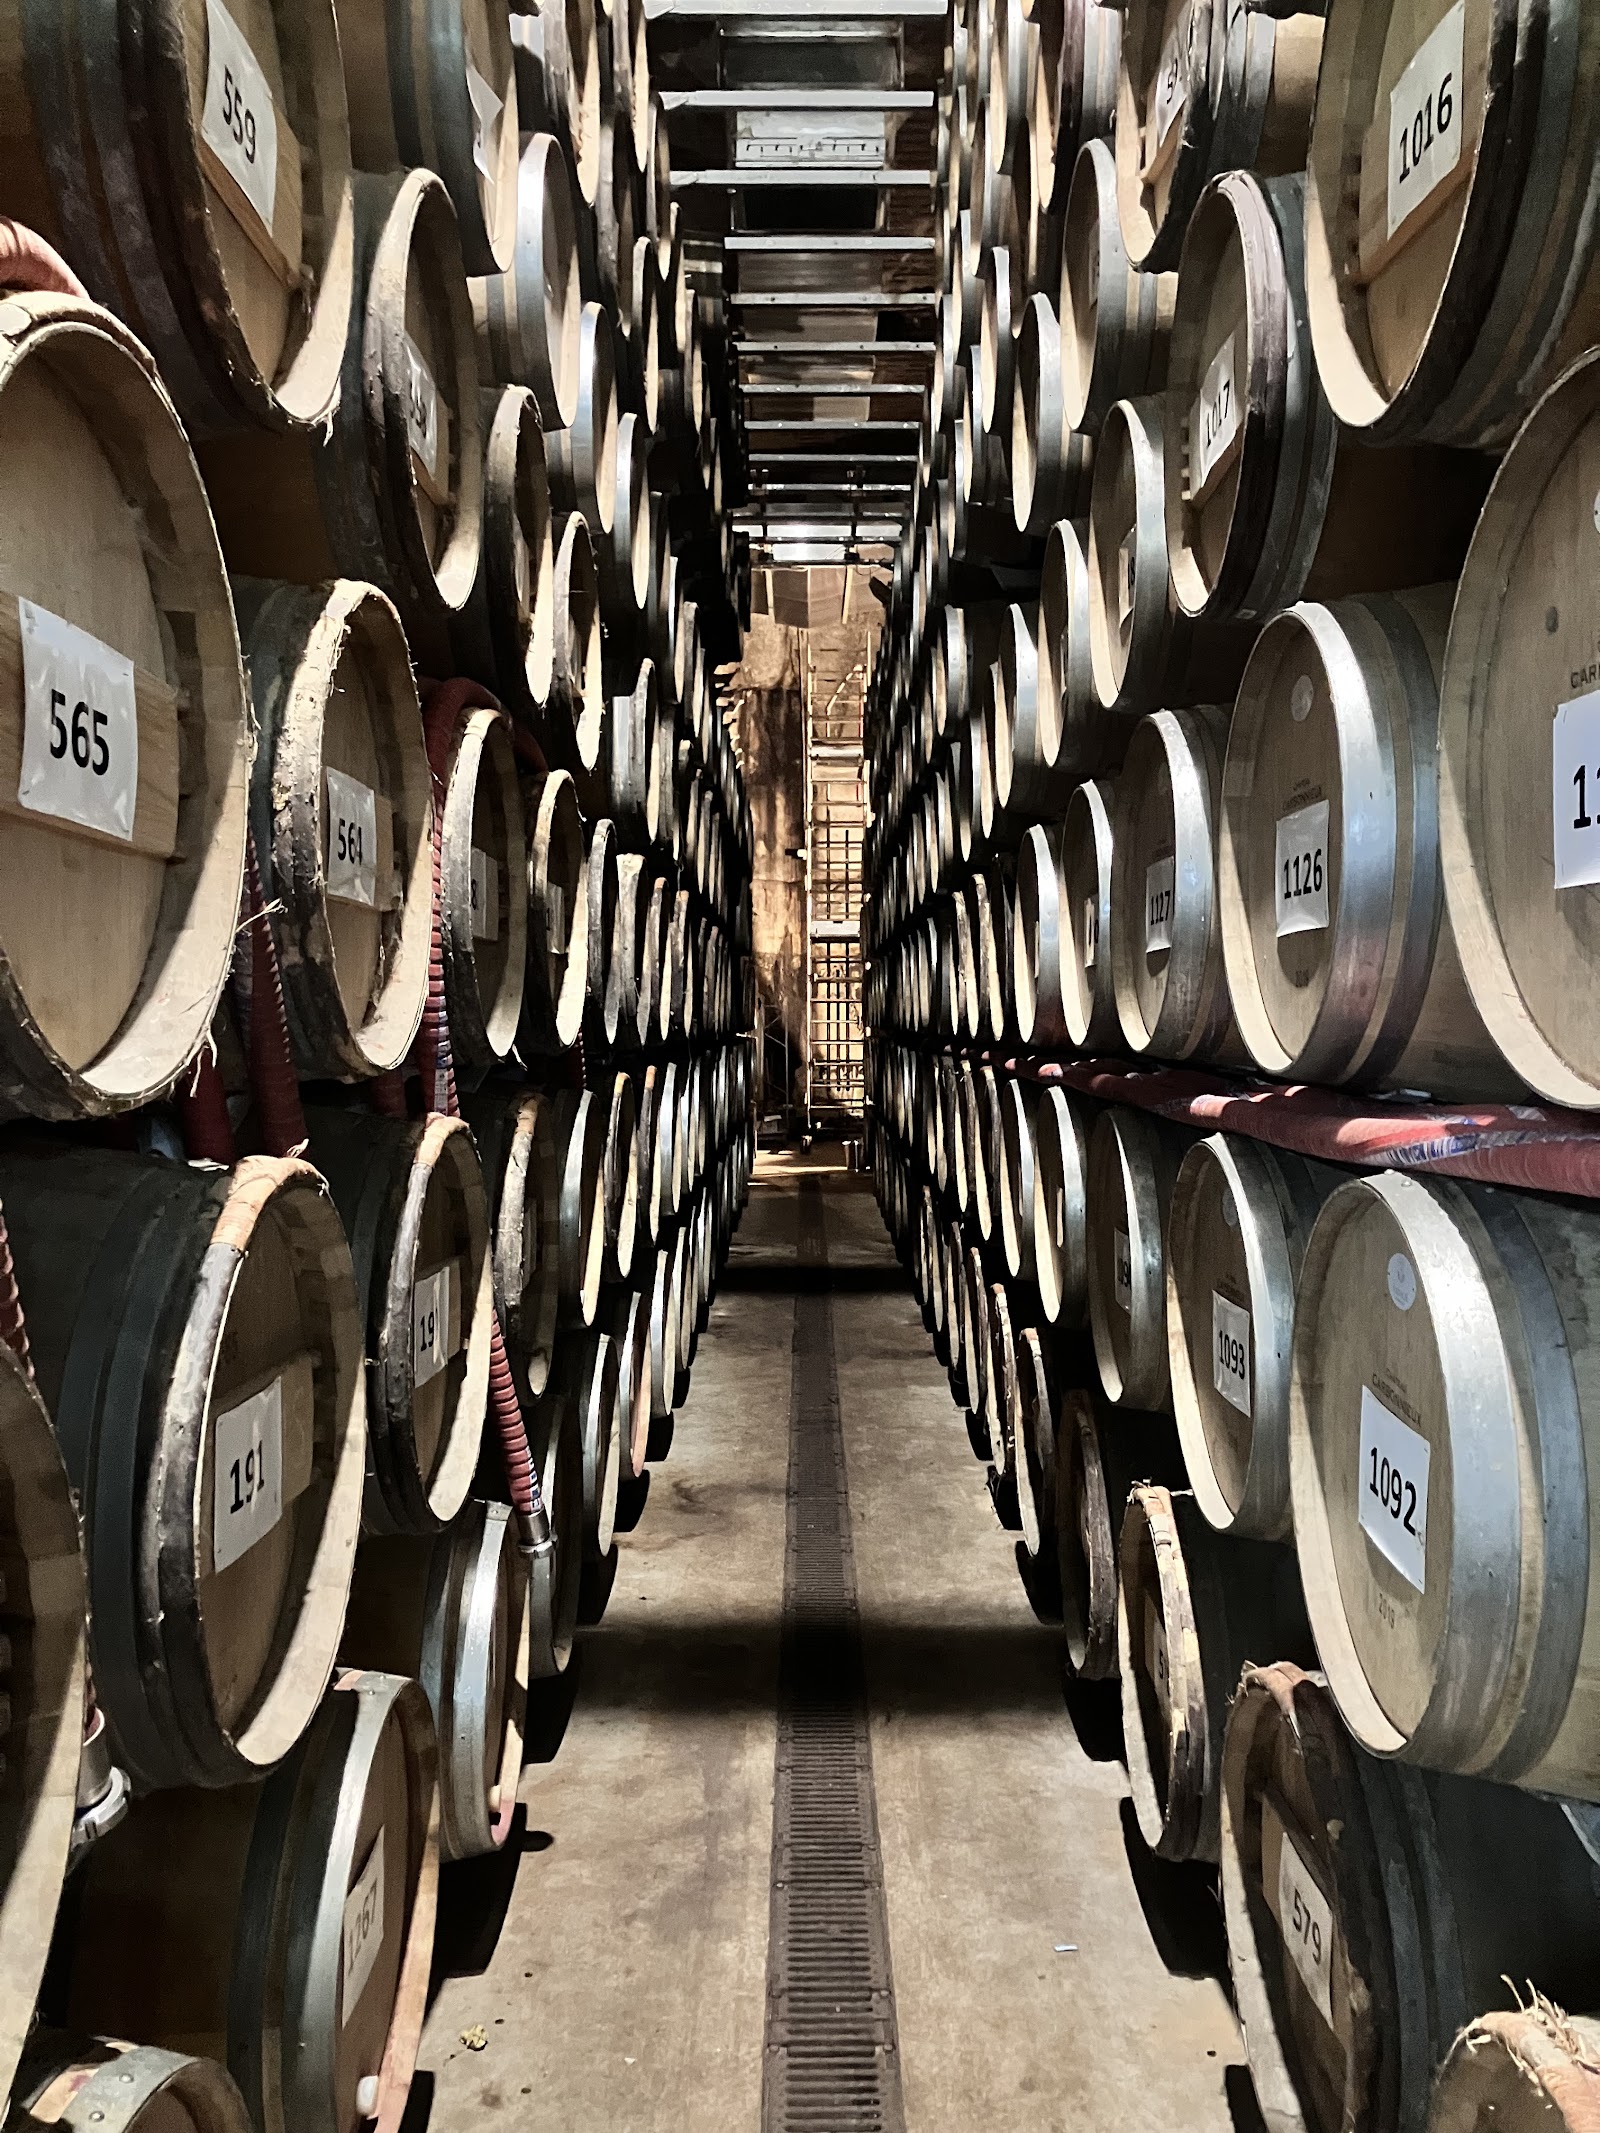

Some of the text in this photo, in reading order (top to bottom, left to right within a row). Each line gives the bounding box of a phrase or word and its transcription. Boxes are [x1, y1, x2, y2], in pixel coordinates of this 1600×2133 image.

[222, 65, 256, 164] 559
[1399, 72, 1452, 184] 1016
[1206, 379, 1230, 449] 1017
[50, 689, 109, 775] 565
[1151, 890, 1170, 926] 1127
[1284, 848, 1322, 899] 1126
[1219, 1329, 1245, 1380] 1093
[230, 1440, 264, 1515] 191
[1369, 1446, 1417, 1537] 1092
[1293, 1886, 1321, 1966] 579
